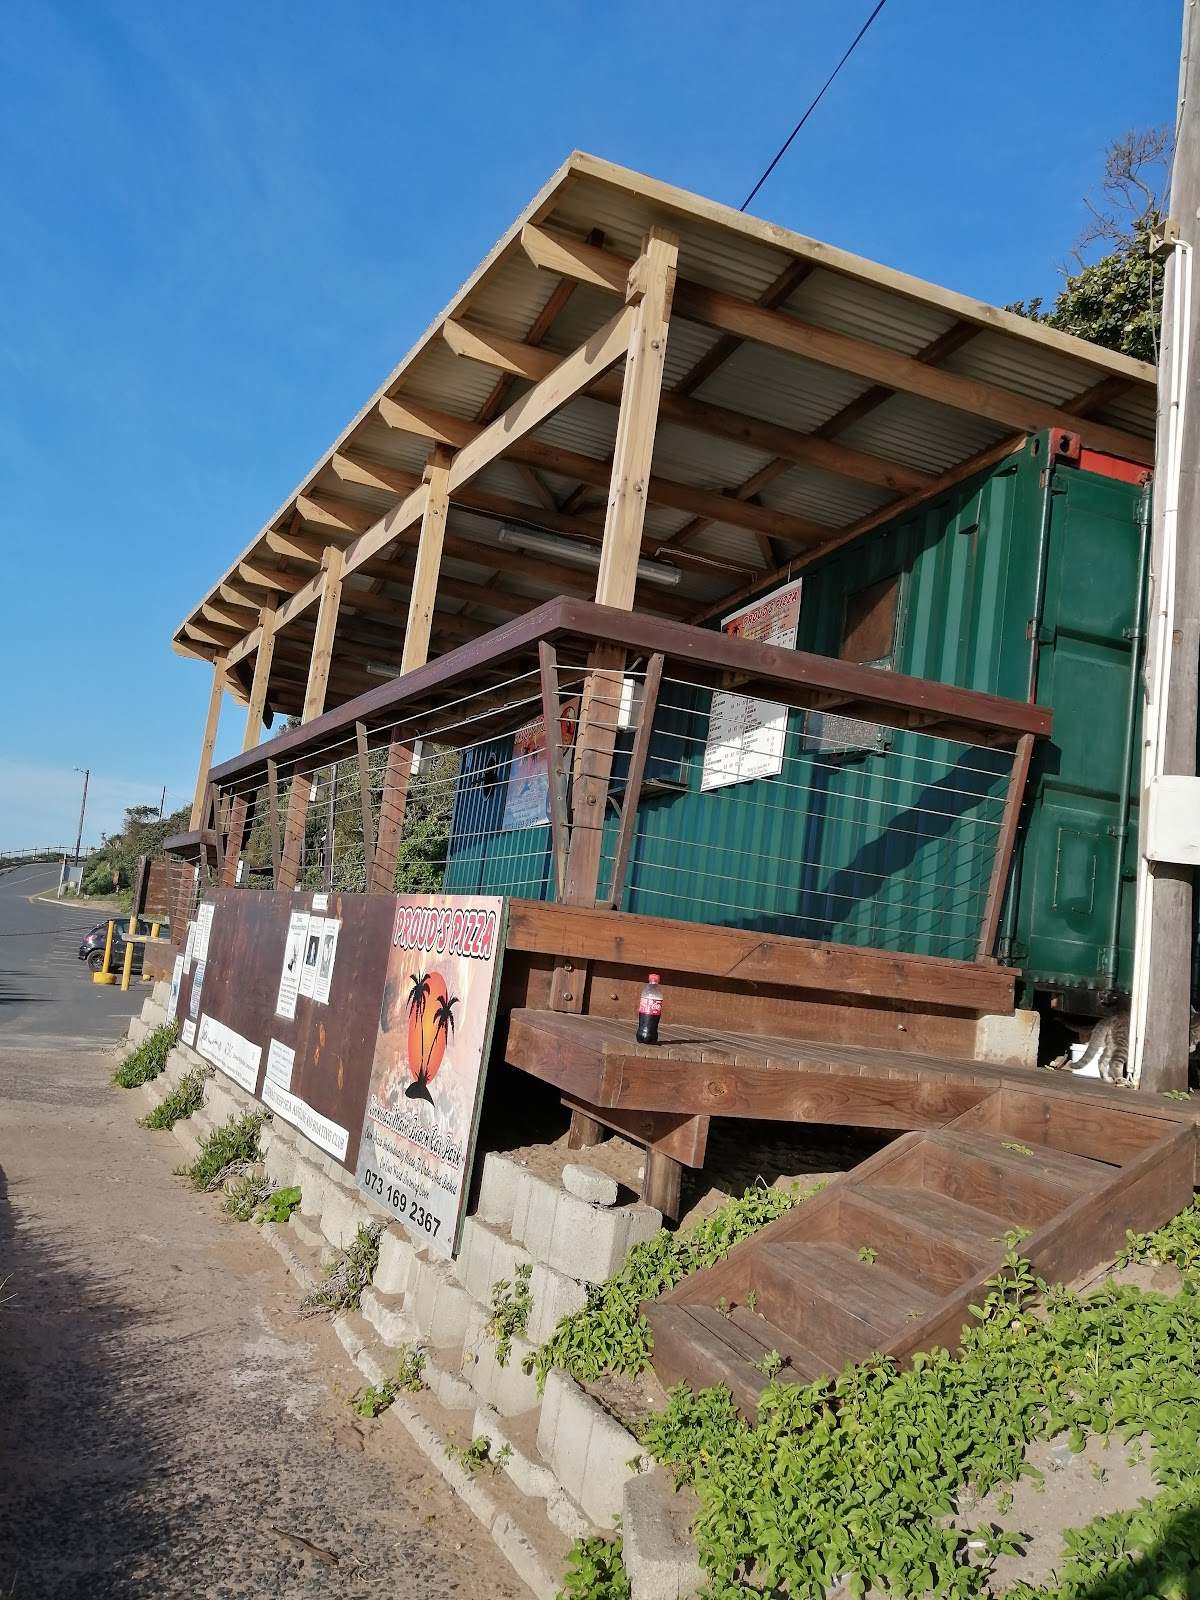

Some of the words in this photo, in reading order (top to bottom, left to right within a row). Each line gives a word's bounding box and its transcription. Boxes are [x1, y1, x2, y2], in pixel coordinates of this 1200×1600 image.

[775, 590, 799, 608] PIZZA
[393, 906, 452, 953] PROUD'S
[449, 908, 496, 960] PIZZA
[332, 1130, 345, 1151] CLUB
[408, 1114, 430, 1151] Beach
[442, 1132, 463, 1168] Park
[365, 1168, 384, 1195] 073
[387, 1185, 407, 1212] 169
[409, 1201, 441, 1237] 2367
